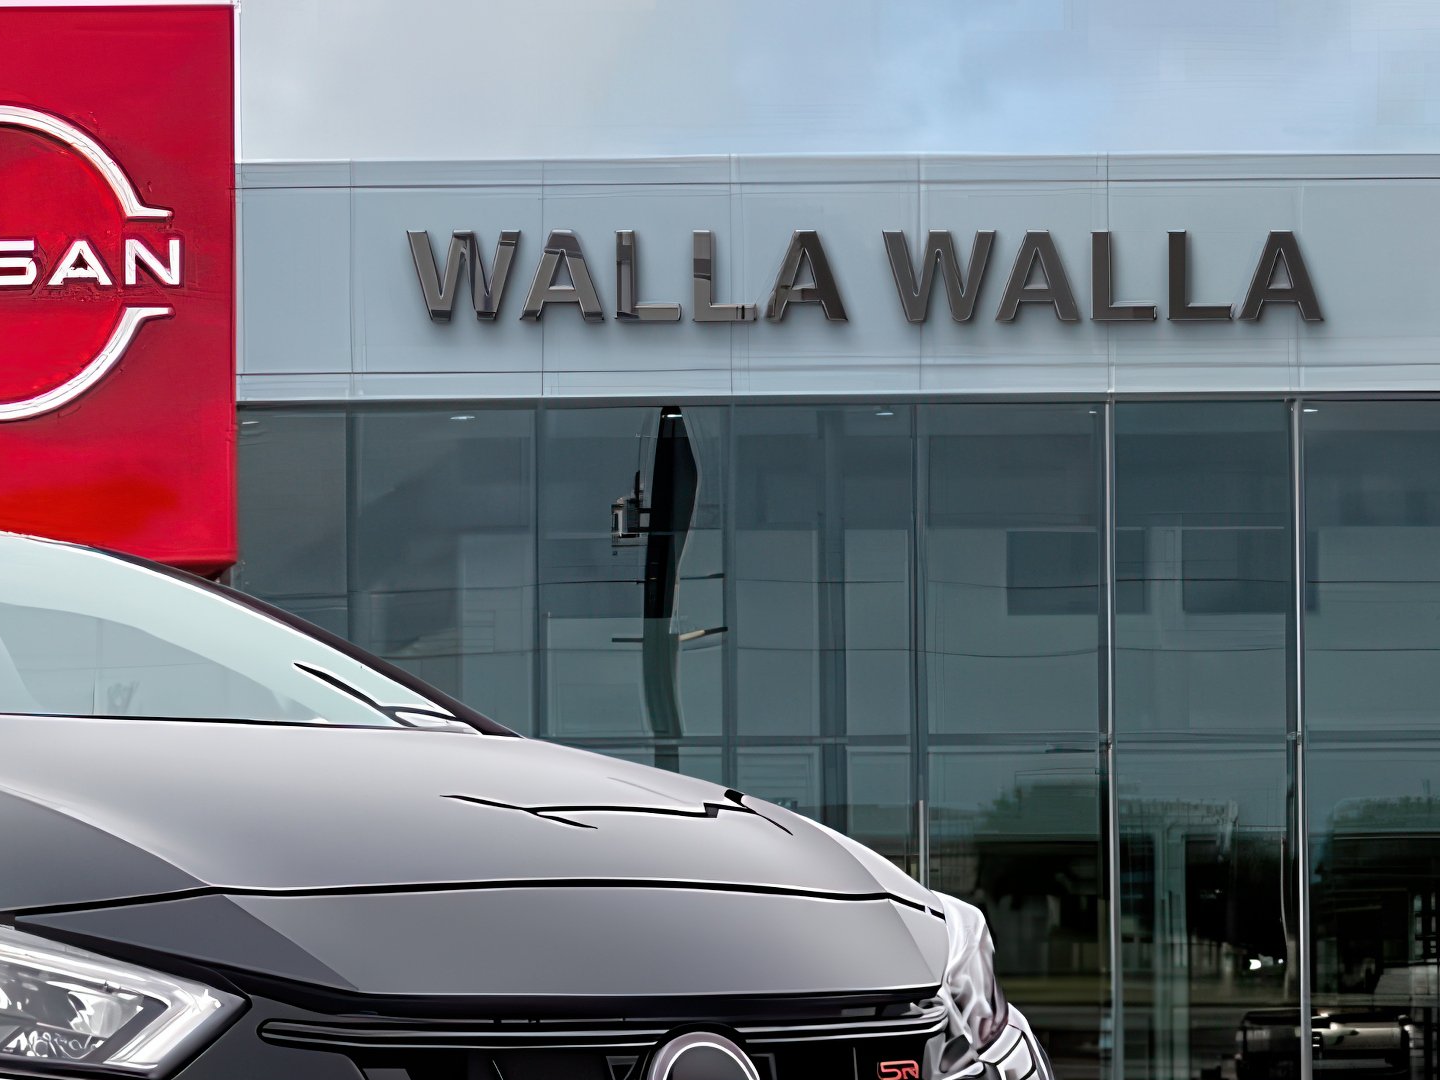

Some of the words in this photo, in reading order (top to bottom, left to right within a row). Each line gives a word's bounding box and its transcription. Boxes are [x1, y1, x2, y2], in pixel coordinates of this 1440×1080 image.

[405, 228, 849, 323] WALLA
[881, 228, 1325, 323] WALLA
[877, 1060, 919, 1080] SR
